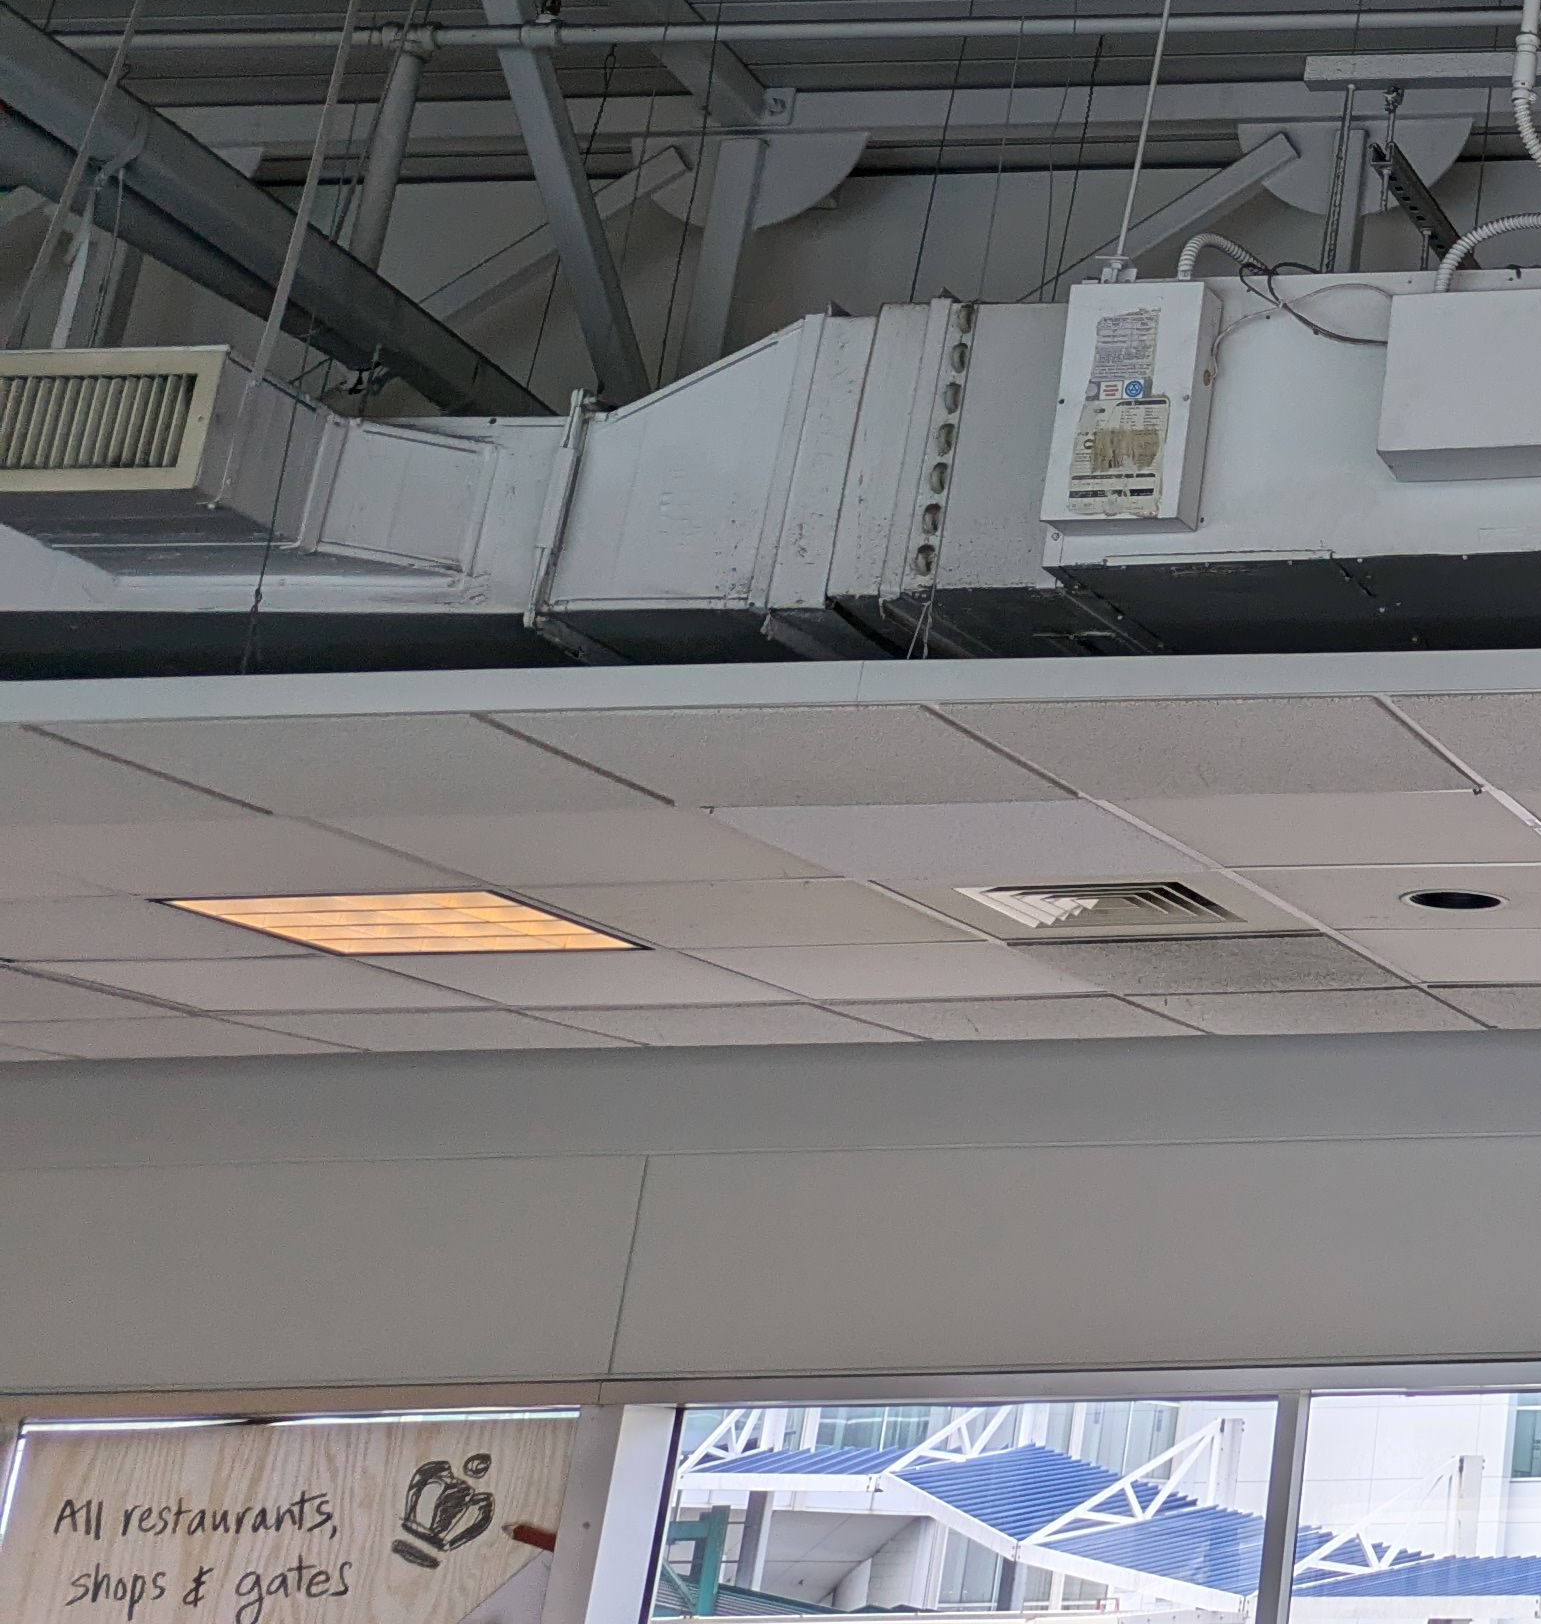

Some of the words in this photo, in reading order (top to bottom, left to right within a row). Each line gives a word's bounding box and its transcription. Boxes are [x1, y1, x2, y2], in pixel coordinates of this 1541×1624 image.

[54, 1498, 104, 1540] All
[120, 1490, 338, 1541] restaurants,
[65, 1562, 167, 1622] shops
[182, 1565, 216, 1608] &
[234, 1554, 353, 1624] gates
